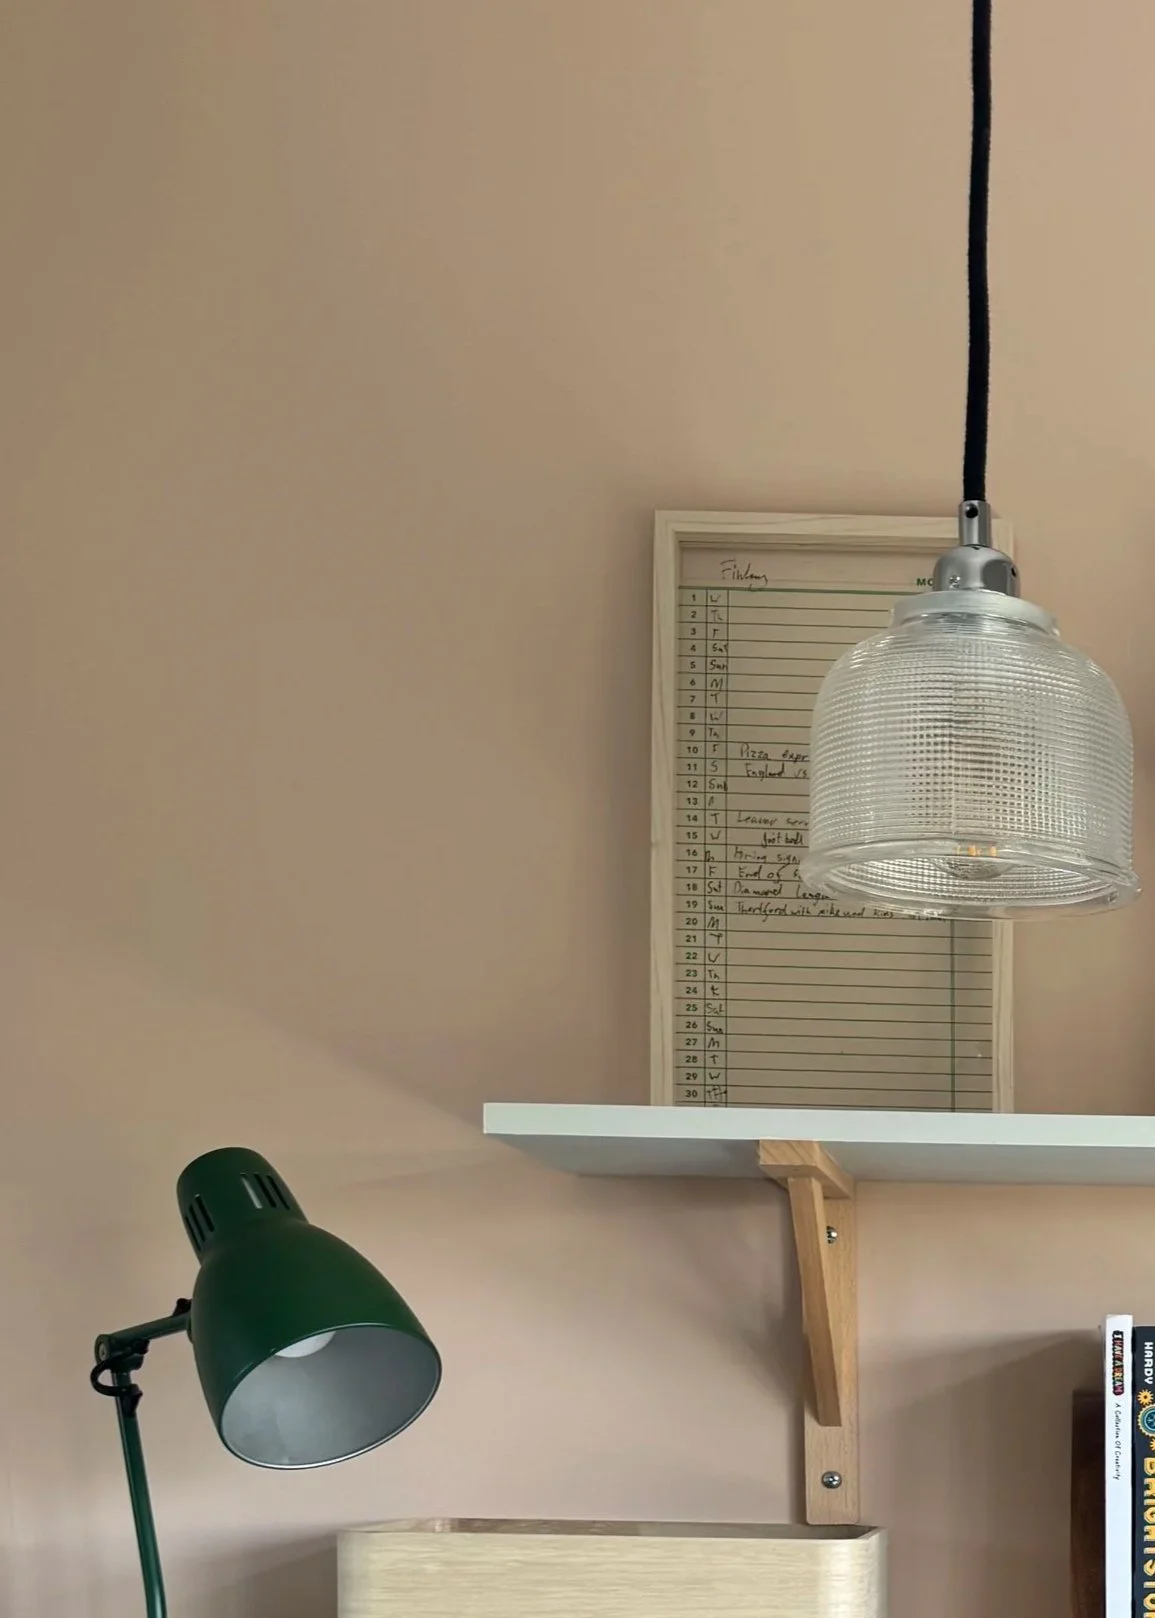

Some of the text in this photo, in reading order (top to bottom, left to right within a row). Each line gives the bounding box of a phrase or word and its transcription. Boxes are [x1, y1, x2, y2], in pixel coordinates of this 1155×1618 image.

[691, 594, 697, 602] 1
[690, 611, 697, 619] 2
[690, 628, 697, 636] 3
[690, 695, 696, 703] 7
[710, 693, 720, 704] T
[690, 712, 696, 720] 8
[689, 729, 696, 737] 9
[687, 746, 698, 754] 10
[782, 750, 808, 763] expr
[687, 763, 697, 771] 11
[687, 798, 698, 806] 13
[710, 813, 720, 824] T
[710, 831, 721, 839] W
[686, 849, 698, 857] 16
[686, 866, 698, 874] 17
[709, 866, 717, 876] F
[686, 883, 698, 891] 18
[686, 952, 698, 960] 22
[686, 969, 698, 977] 23
[686, 1021, 698, 1029] 26
[686, 1038, 698, 1046] 27
[685, 1055, 698, 1063] 28
[709, 1072, 721, 1080] W
[685, 1090, 698, 1098] 30
[1144, 1341, 1153, 1385] HARDY
[1113, 1451, 1121, 1481] Creativity
